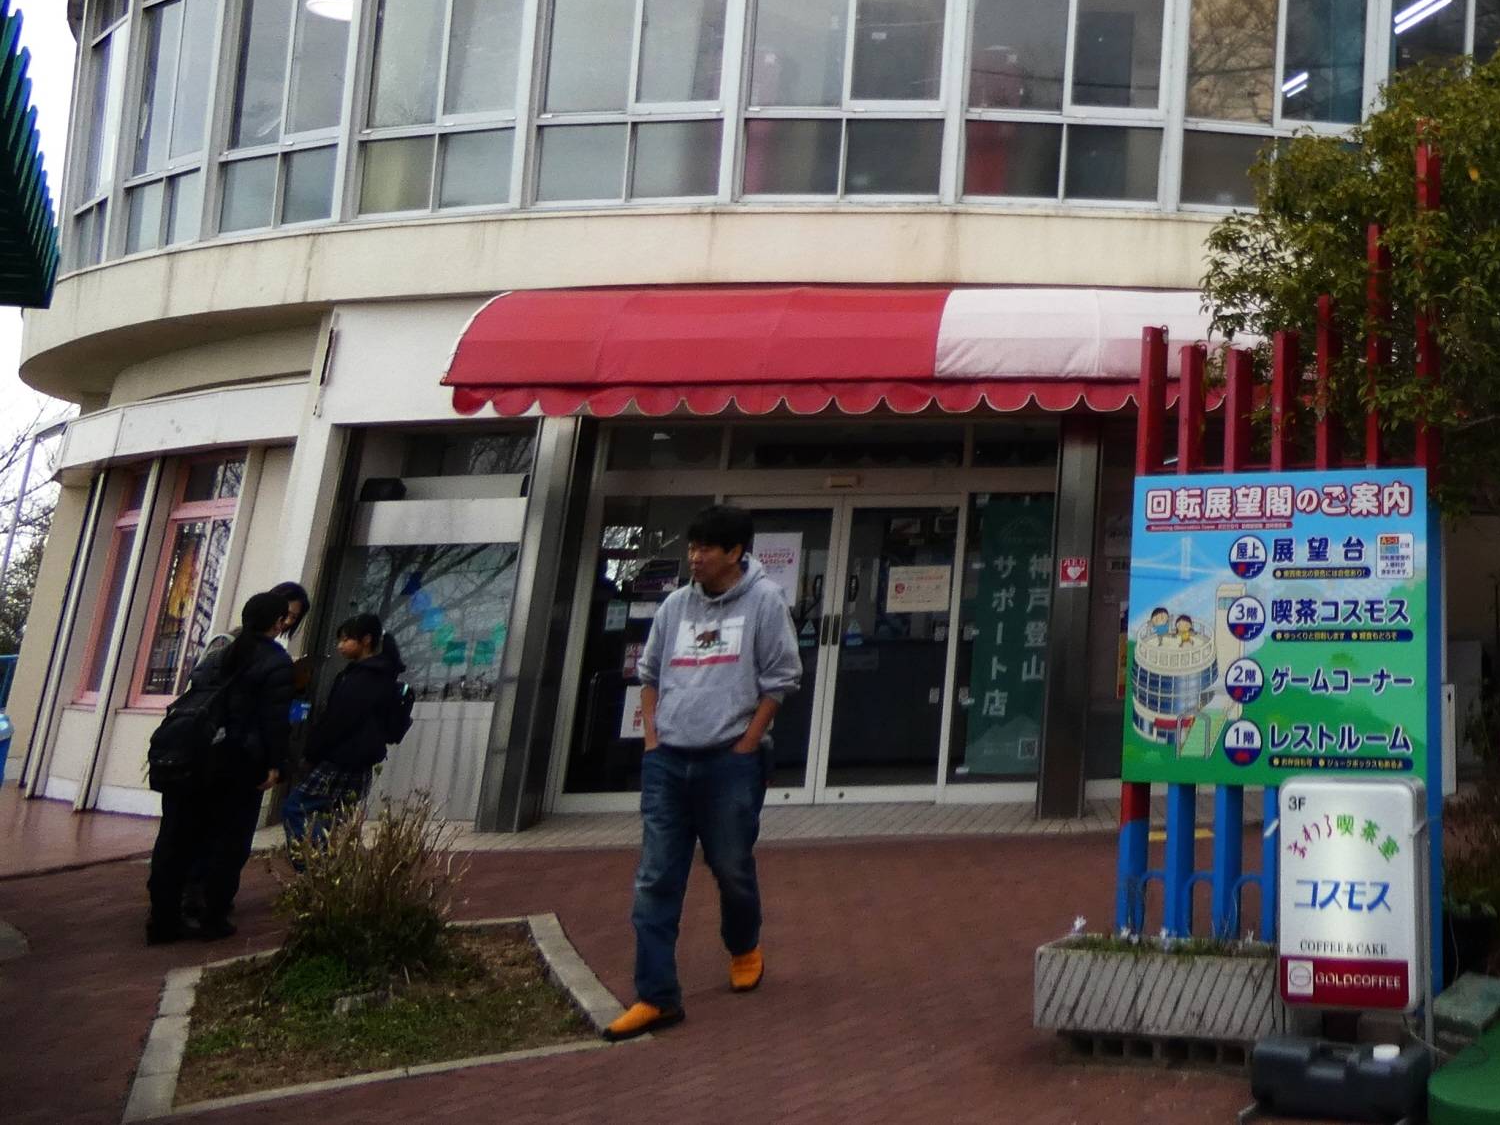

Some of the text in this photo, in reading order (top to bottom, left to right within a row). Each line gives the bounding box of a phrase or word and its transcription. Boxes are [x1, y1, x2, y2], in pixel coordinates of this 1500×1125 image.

[1146, 482, 1412, 521] 回転展望閣のご案内
[1236, 542, 1260, 560] 屋上
[1271, 535, 1365, 564] 展望台
[1022, 553, 1052, 681] 神戸登山
[1235, 604, 1258, 621] 3階
[1271, 598, 1410, 625] 喫茶コスモス
[982, 554, 1016, 717] サポート店
[1233, 665, 1257, 683] 2階
[1271, 666, 1413, 694] ゲームコーナー
[1233, 727, 1255, 745] 1階
[1269, 724, 1412, 753] レストルーム
[1288, 796, 1306, 811] 3F
[1294, 879, 1392, 913] コスモス
[1300, 939, 1344, 954] COFFEE
[1356, 942, 1388, 956] CAKE
